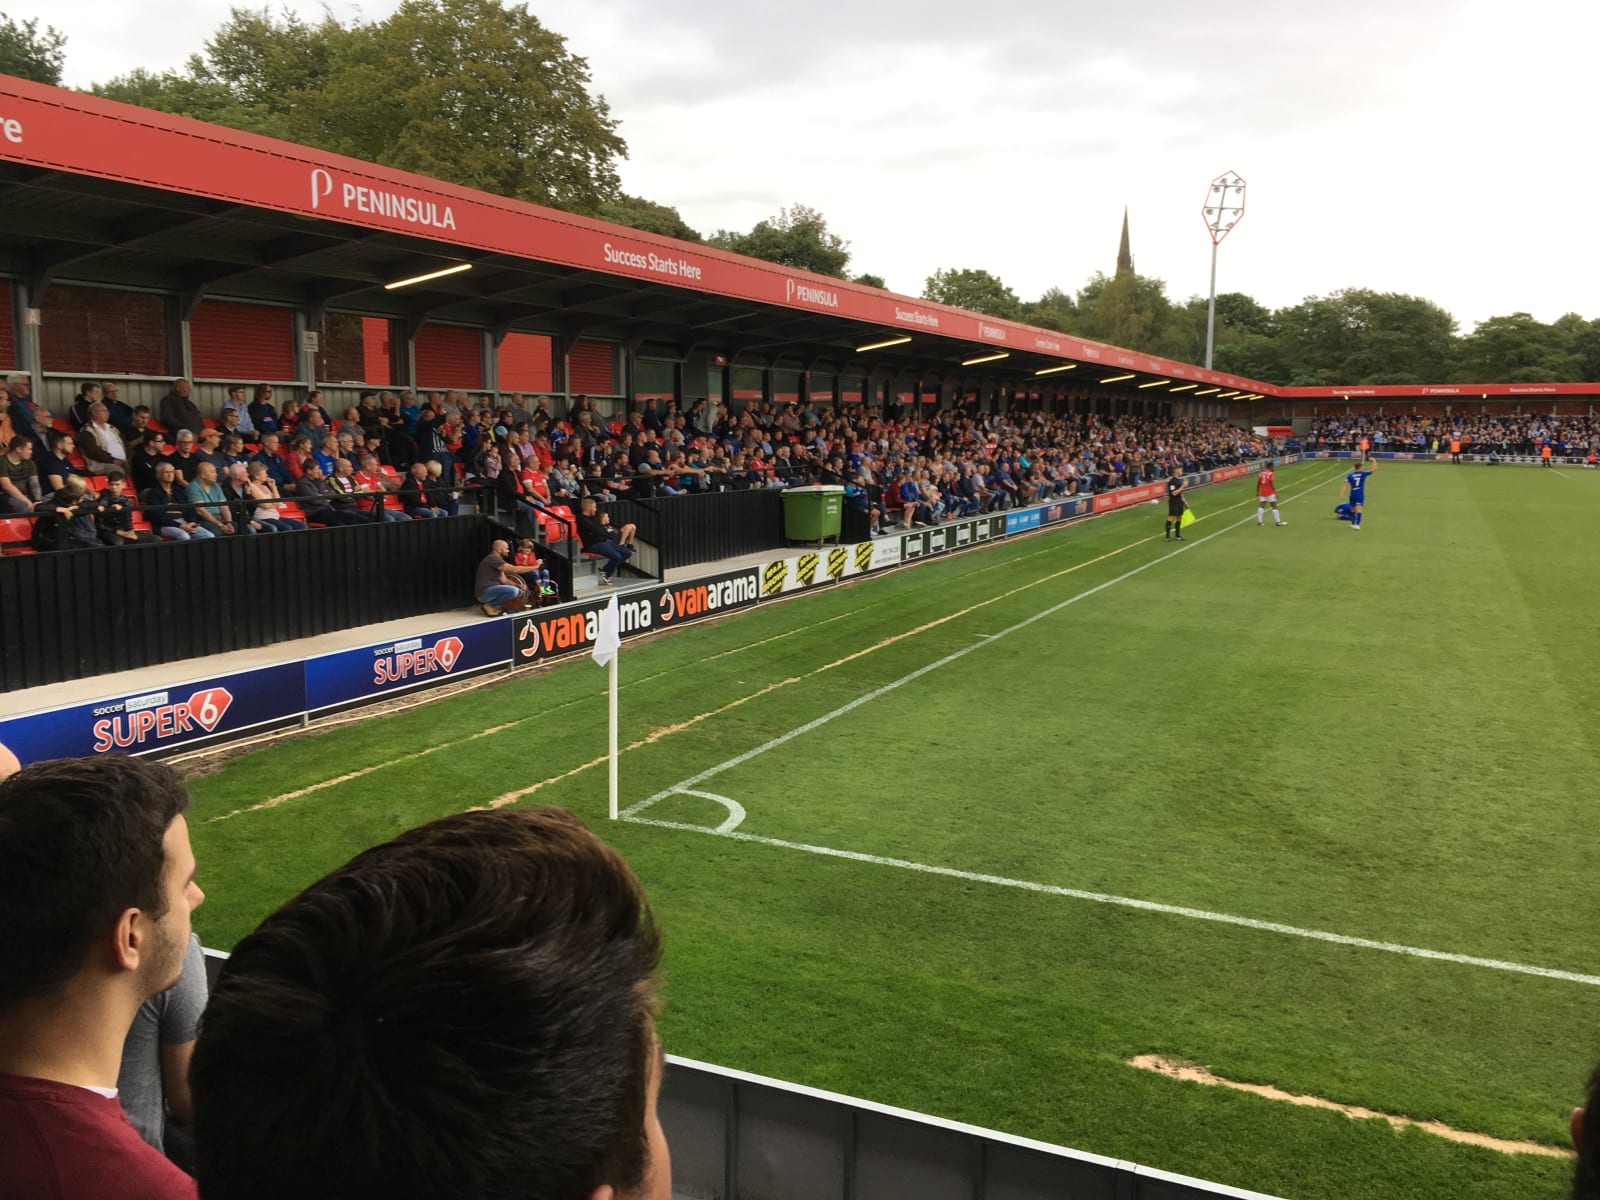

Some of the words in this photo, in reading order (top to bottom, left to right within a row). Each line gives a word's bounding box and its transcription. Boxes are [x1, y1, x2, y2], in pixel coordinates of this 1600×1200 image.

[343, 183, 456, 230] PENINSULA
[604, 243, 647, 269] Success
[648, 253, 678, 276] Starts
[679, 260, 702, 279] Here
[797, 286, 838, 308] PENINSULA
[674, 575, 758, 618] vanarama
[541, 600, 652, 651] vanarma
[374, 648, 438, 685] SUPER
[441, 641, 454, 667] 6
[93, 703, 124, 717] soccer
[93, 702, 193, 753] SUPER
[200, 693, 218, 725] 6
